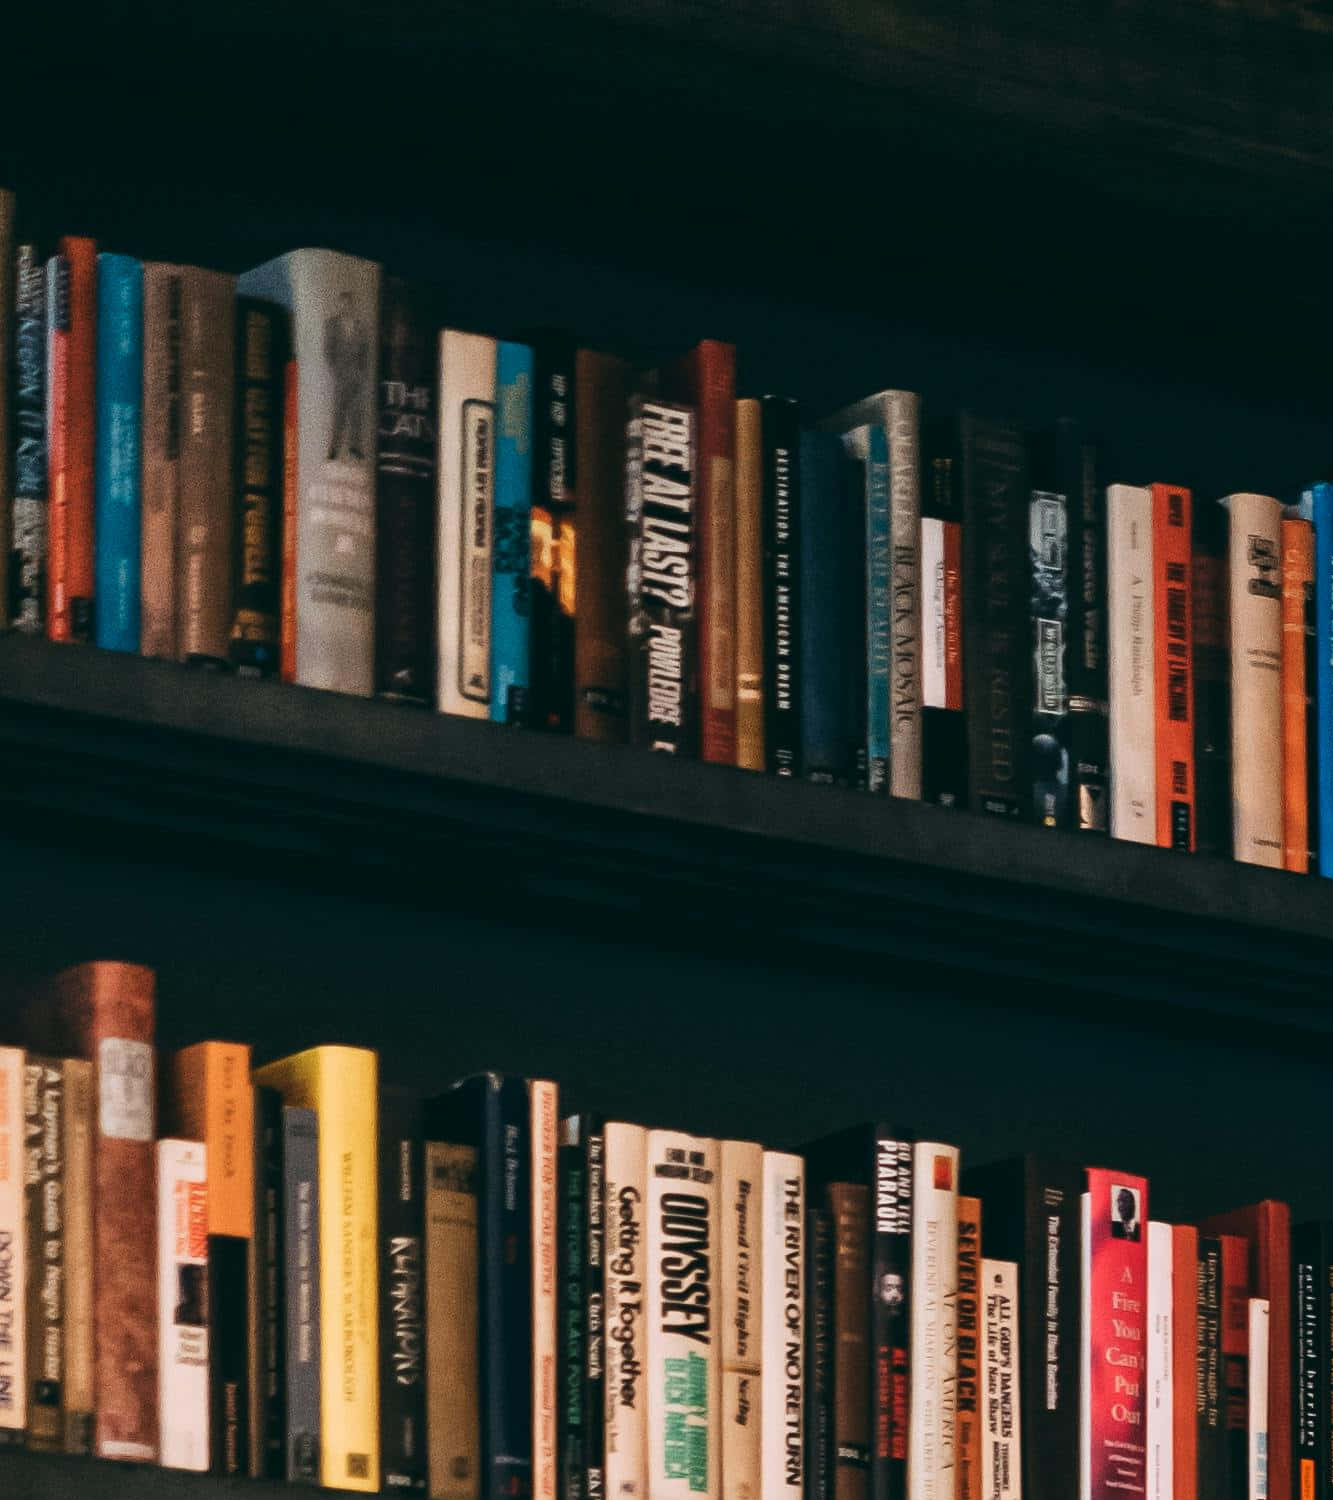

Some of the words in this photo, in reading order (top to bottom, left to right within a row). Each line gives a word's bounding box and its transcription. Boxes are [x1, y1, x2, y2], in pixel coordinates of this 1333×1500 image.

[642, 403, 693, 469] FREE
[645, 471, 690, 508] AT
[646, 517, 693, 609] LAST?
[647, 624, 683, 726] POWLEDGE
[616, 1186, 641, 1274] Getting
[660, 1192, 709, 1345] ODYSSEY
[621, 1280, 641, 1295] It
[618, 1301, 641, 1409] Together
